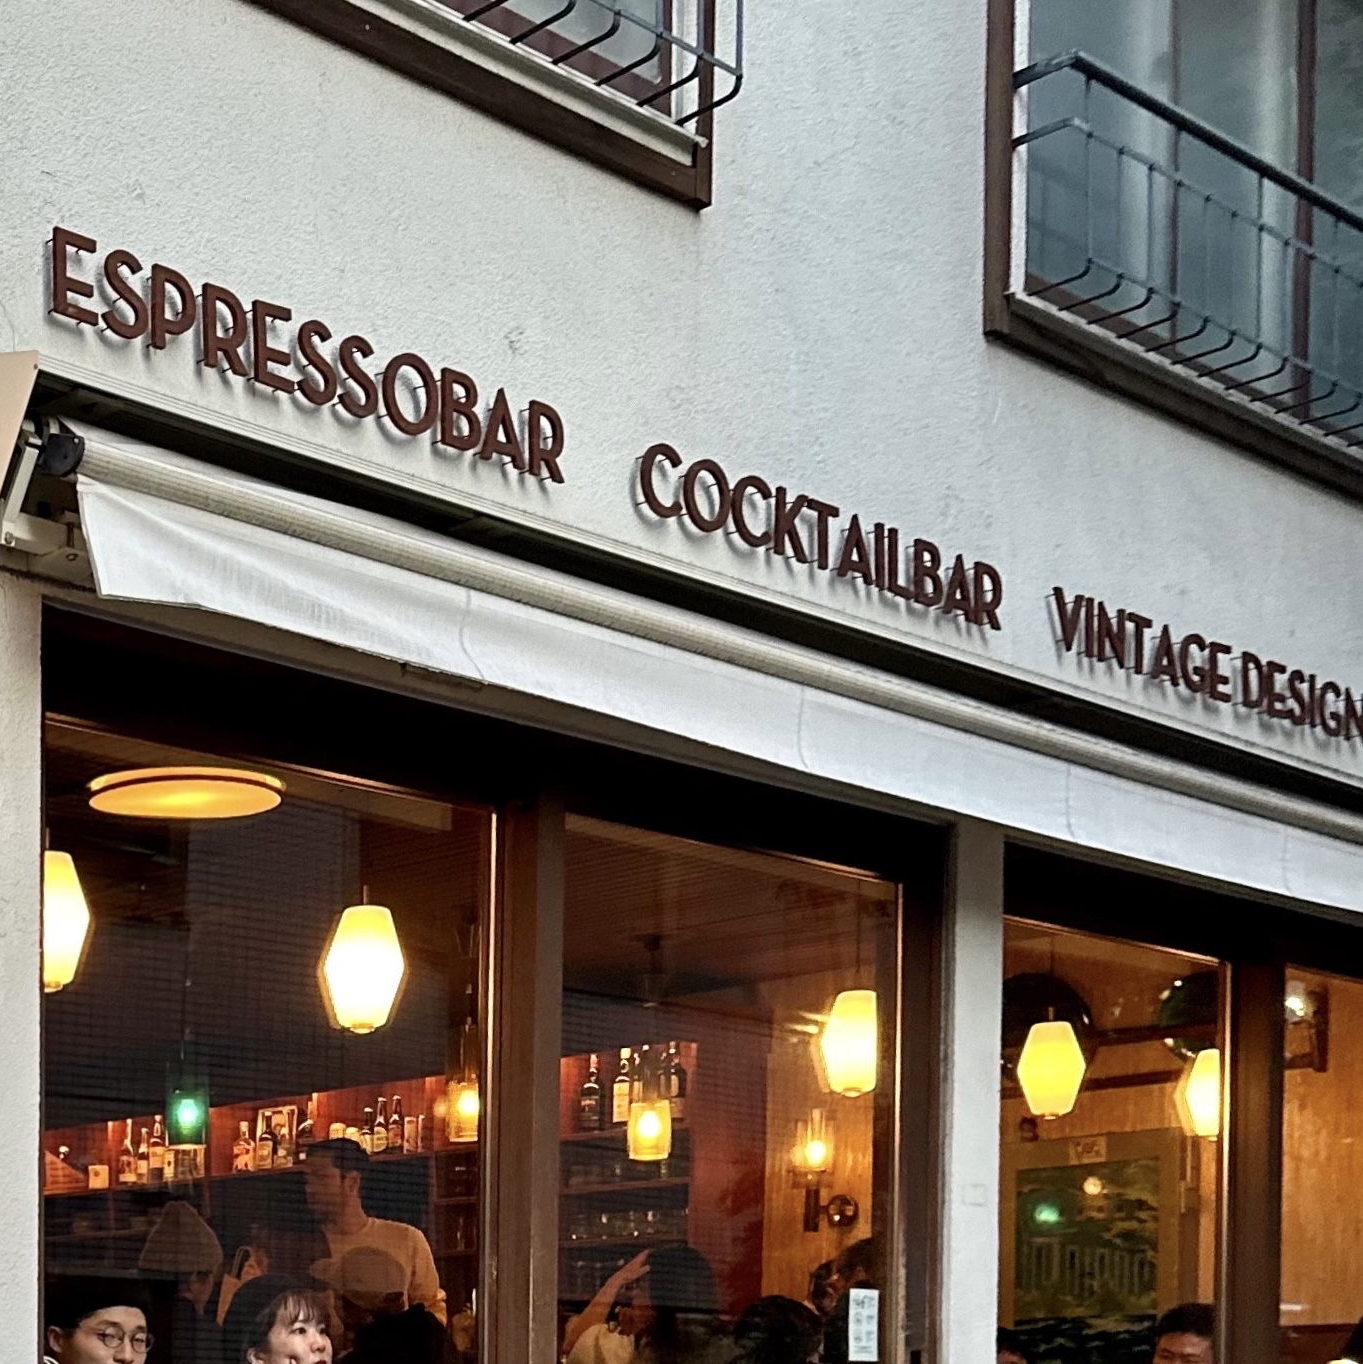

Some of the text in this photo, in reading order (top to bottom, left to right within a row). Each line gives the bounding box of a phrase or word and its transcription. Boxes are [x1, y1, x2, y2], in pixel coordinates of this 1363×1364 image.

[52, 226, 565, 484] ESPRESSOBAR
[639, 443, 1003, 630] COCKTAILBAR
[1052, 586, 1363, 743] VINTAGE DESIGN
